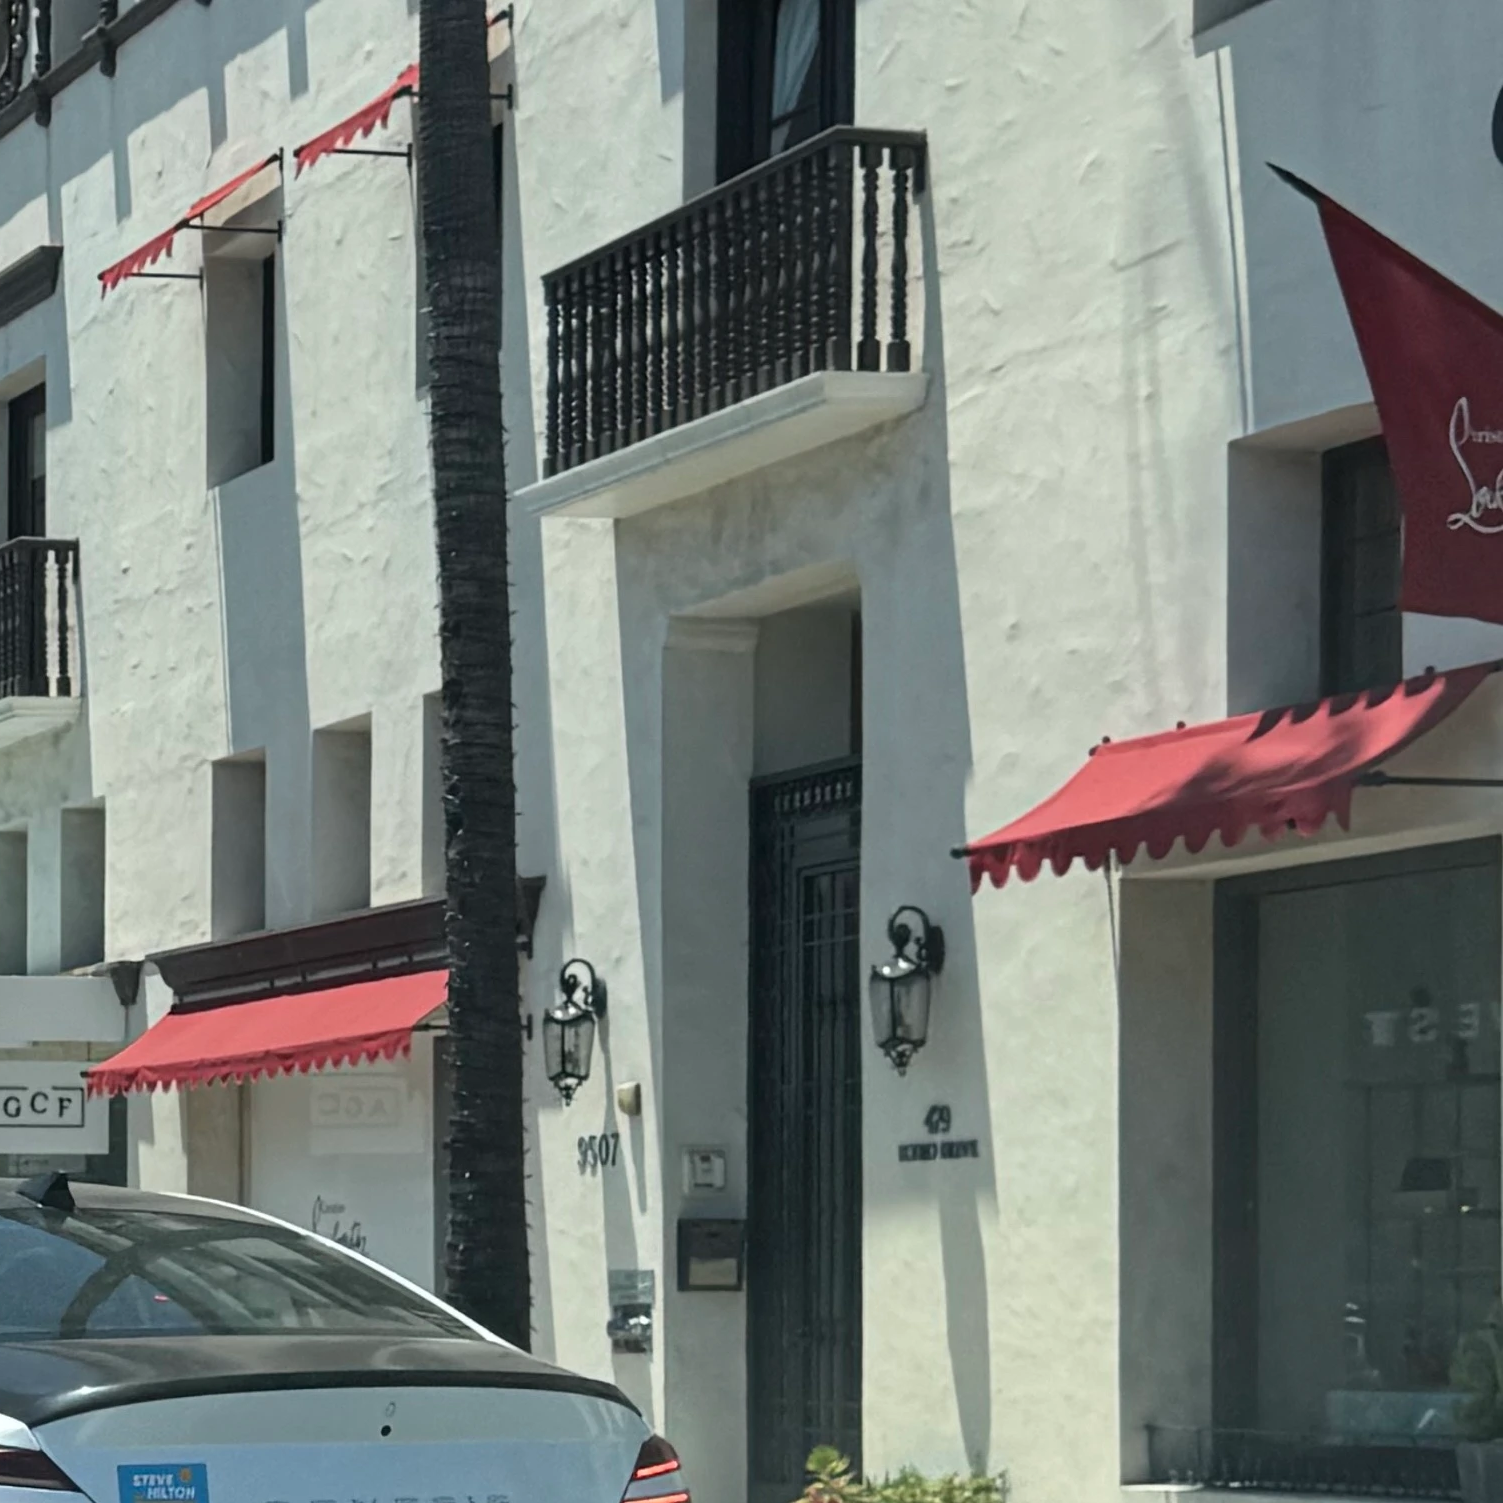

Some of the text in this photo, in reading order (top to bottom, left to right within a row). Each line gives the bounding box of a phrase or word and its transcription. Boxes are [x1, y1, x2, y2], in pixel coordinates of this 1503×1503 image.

[577, 1133, 619, 1170] 9507
[133, 1474, 174, 1487] STEVE
[147, 1486, 196, 1499] HILTON
